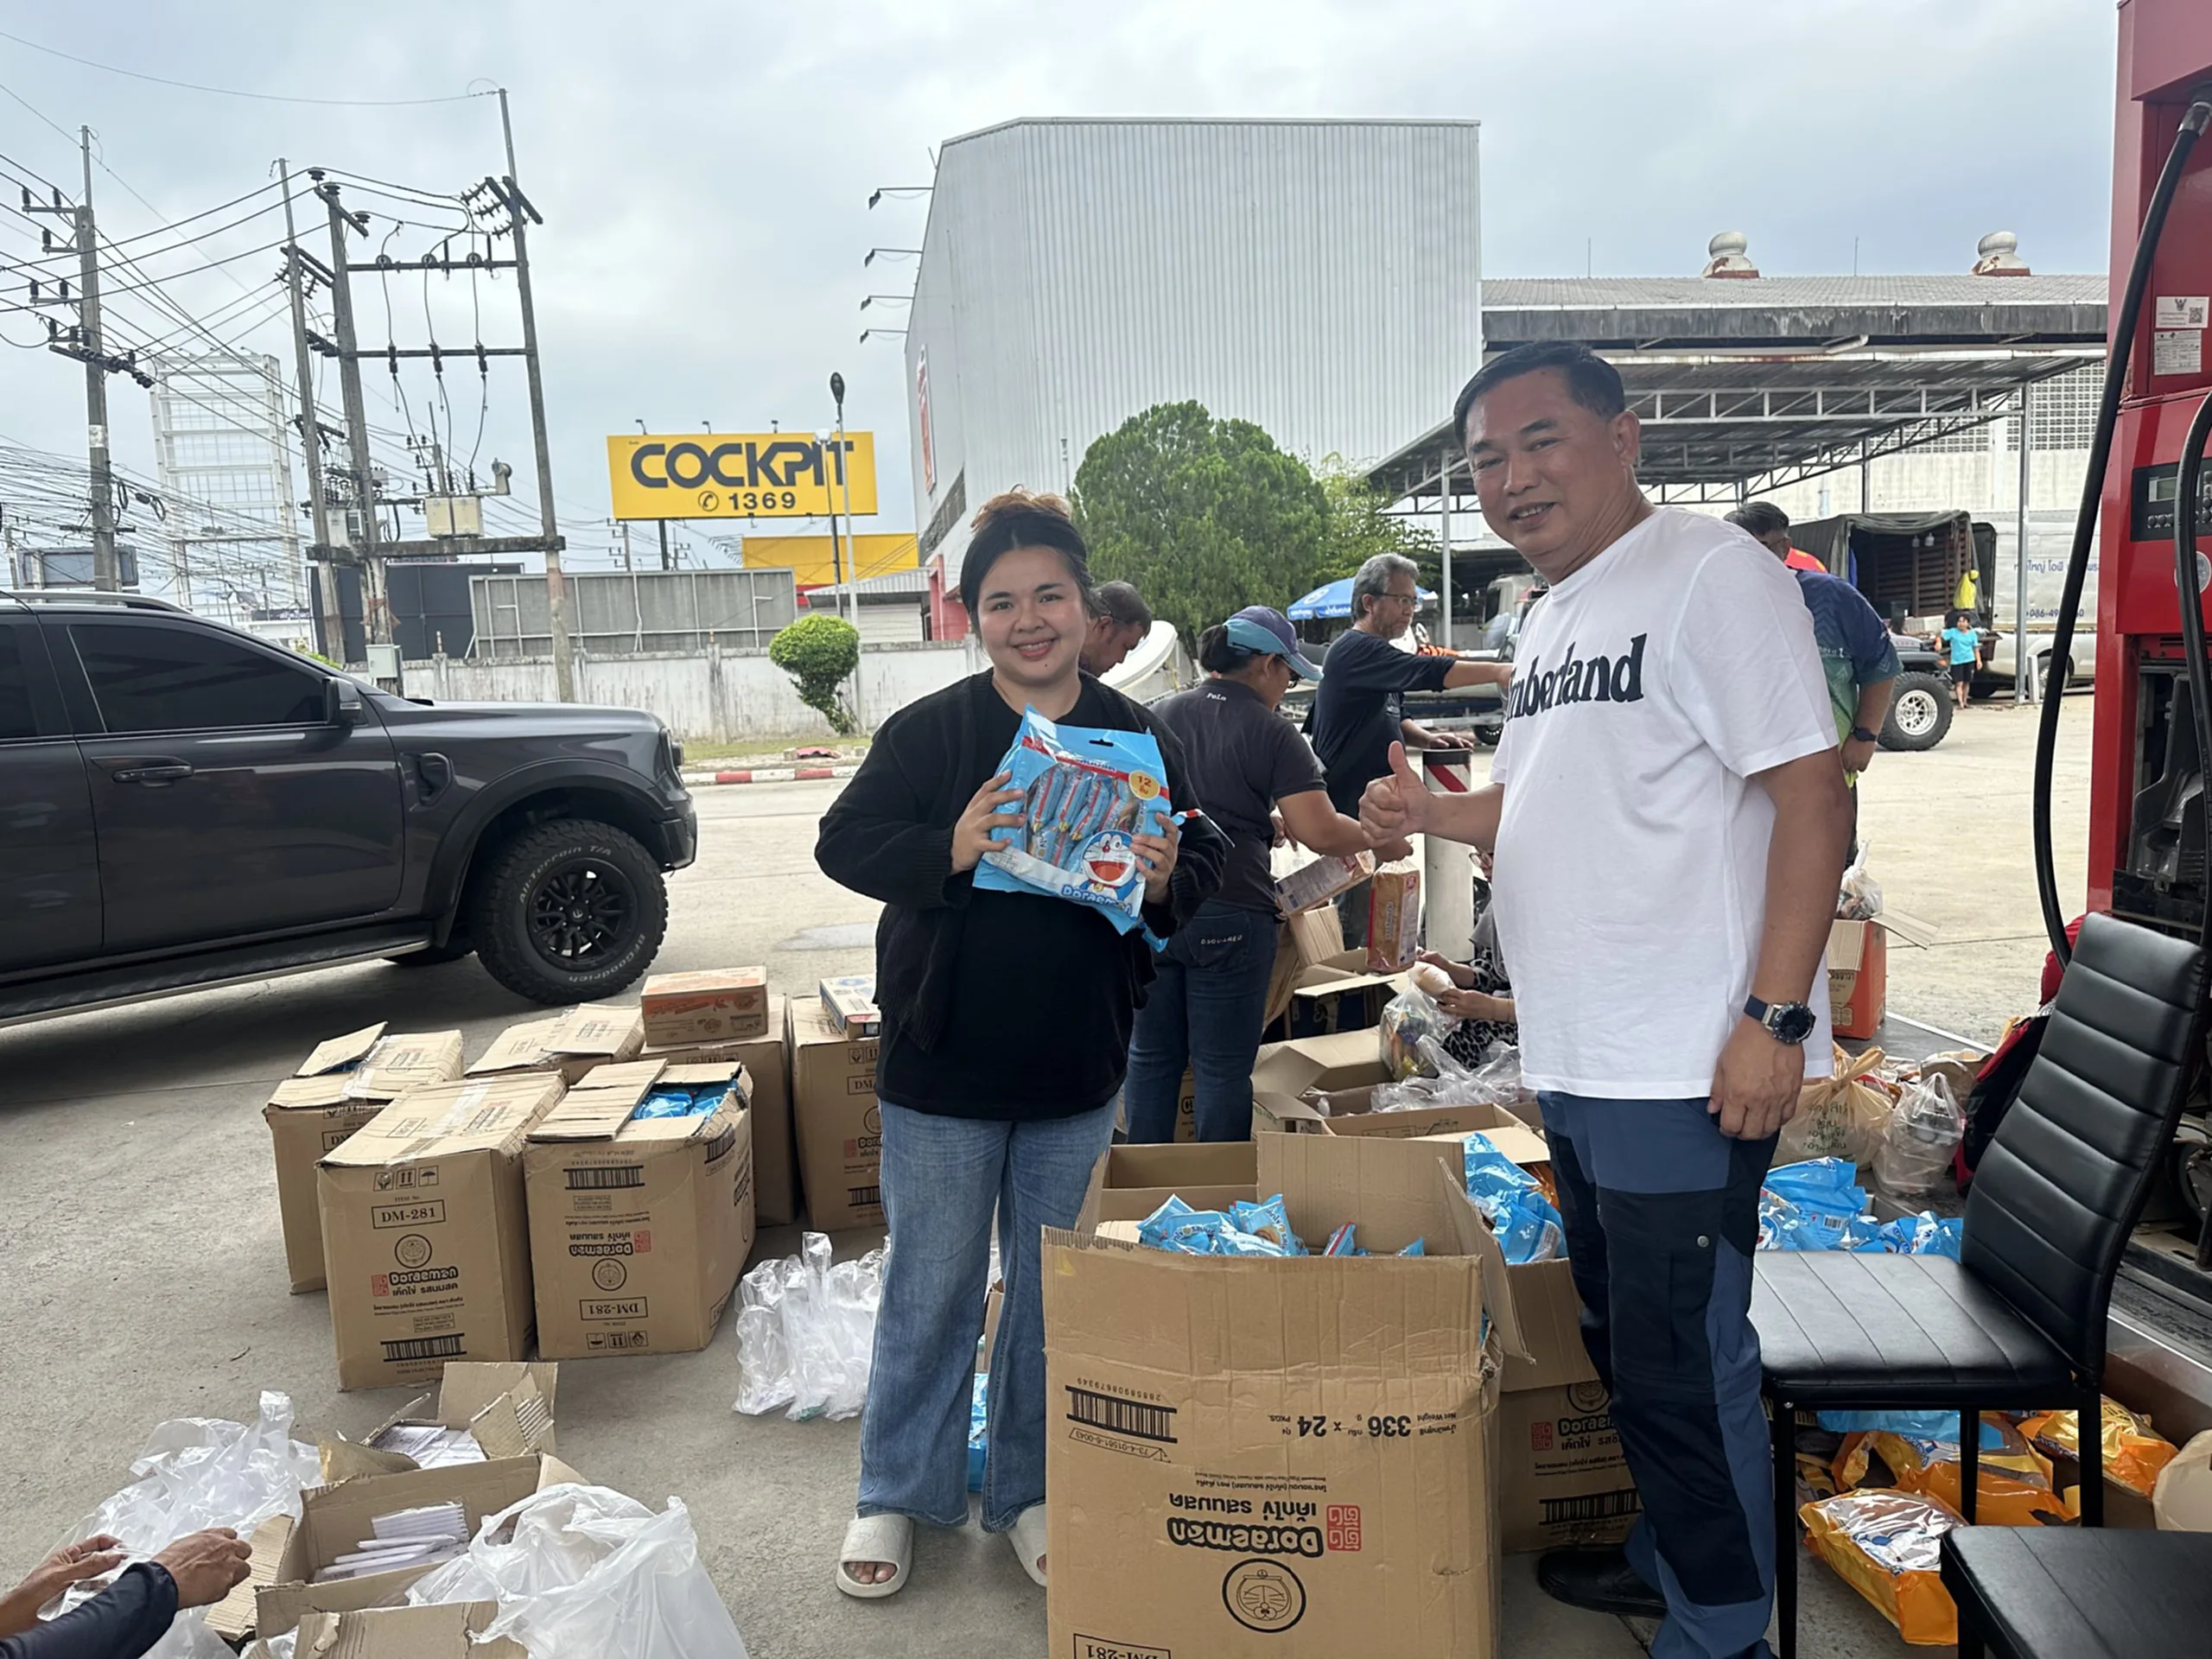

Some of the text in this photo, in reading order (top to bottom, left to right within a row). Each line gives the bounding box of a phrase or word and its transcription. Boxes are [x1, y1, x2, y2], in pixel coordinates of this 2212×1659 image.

[631, 441, 854, 489] COCKPIT
[728, 492, 796, 511] 1369
[1505, 633, 1647, 722] mberland
[1061, 884, 1133, 918] Doraemon
[381, 1207, 435, 1224] DM-281
[569, 1243, 633, 1256] Doraemon
[389, 1267, 459, 1287] Doraemon
[588, 1302, 639, 1315] DM-281
[1297, 1415, 1327, 1437] 24
[1368, 1415, 1411, 1437] 336
[1417, 1412, 1444, 1421] Weight
[1561, 1434, 1591, 1450] เค้กไข่
[1169, 1492, 1317, 1522] เค้กไข่ รสนมสด
[1166, 1516, 1325, 1558] Doraemon
